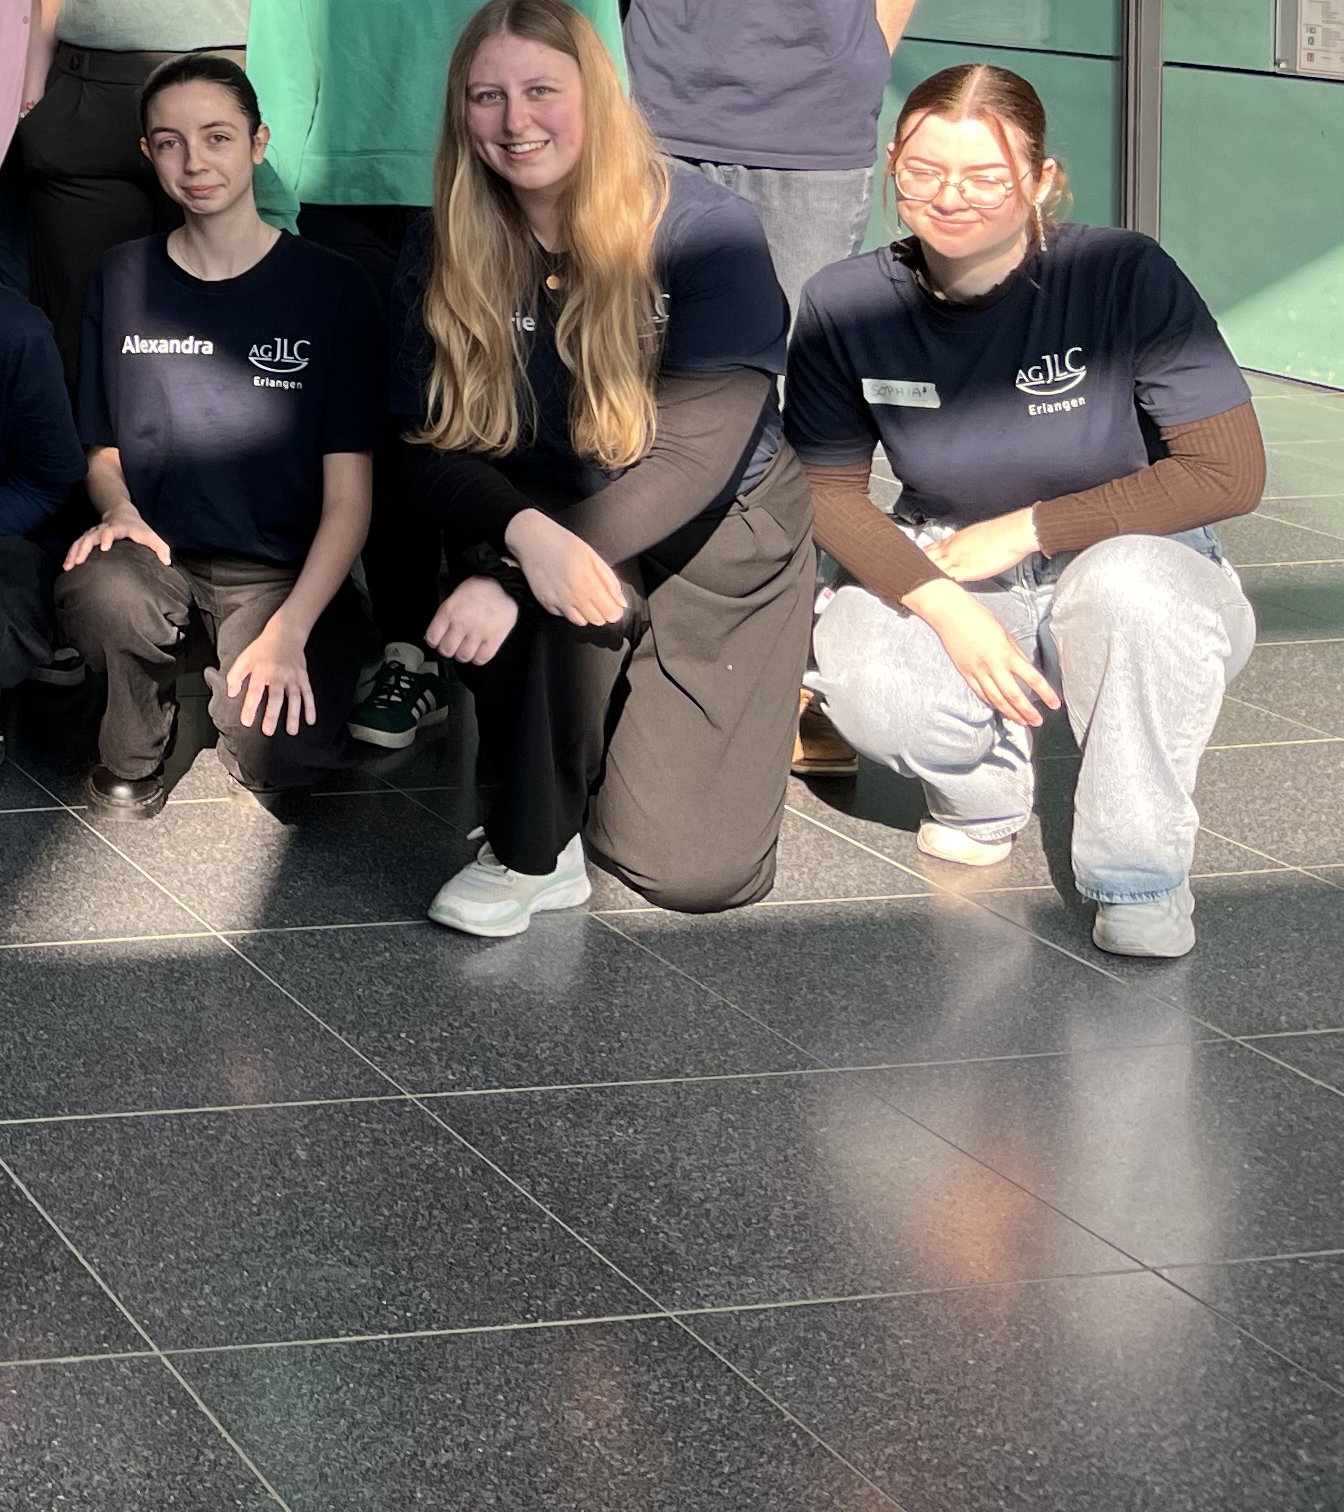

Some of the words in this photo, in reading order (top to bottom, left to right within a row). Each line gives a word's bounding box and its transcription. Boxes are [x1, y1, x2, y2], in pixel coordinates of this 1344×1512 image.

[121, 335, 214, 355] Alexandra
[253, 375, 303, 390] Erlangen
[1028, 395, 1086, 416] Erlangen
